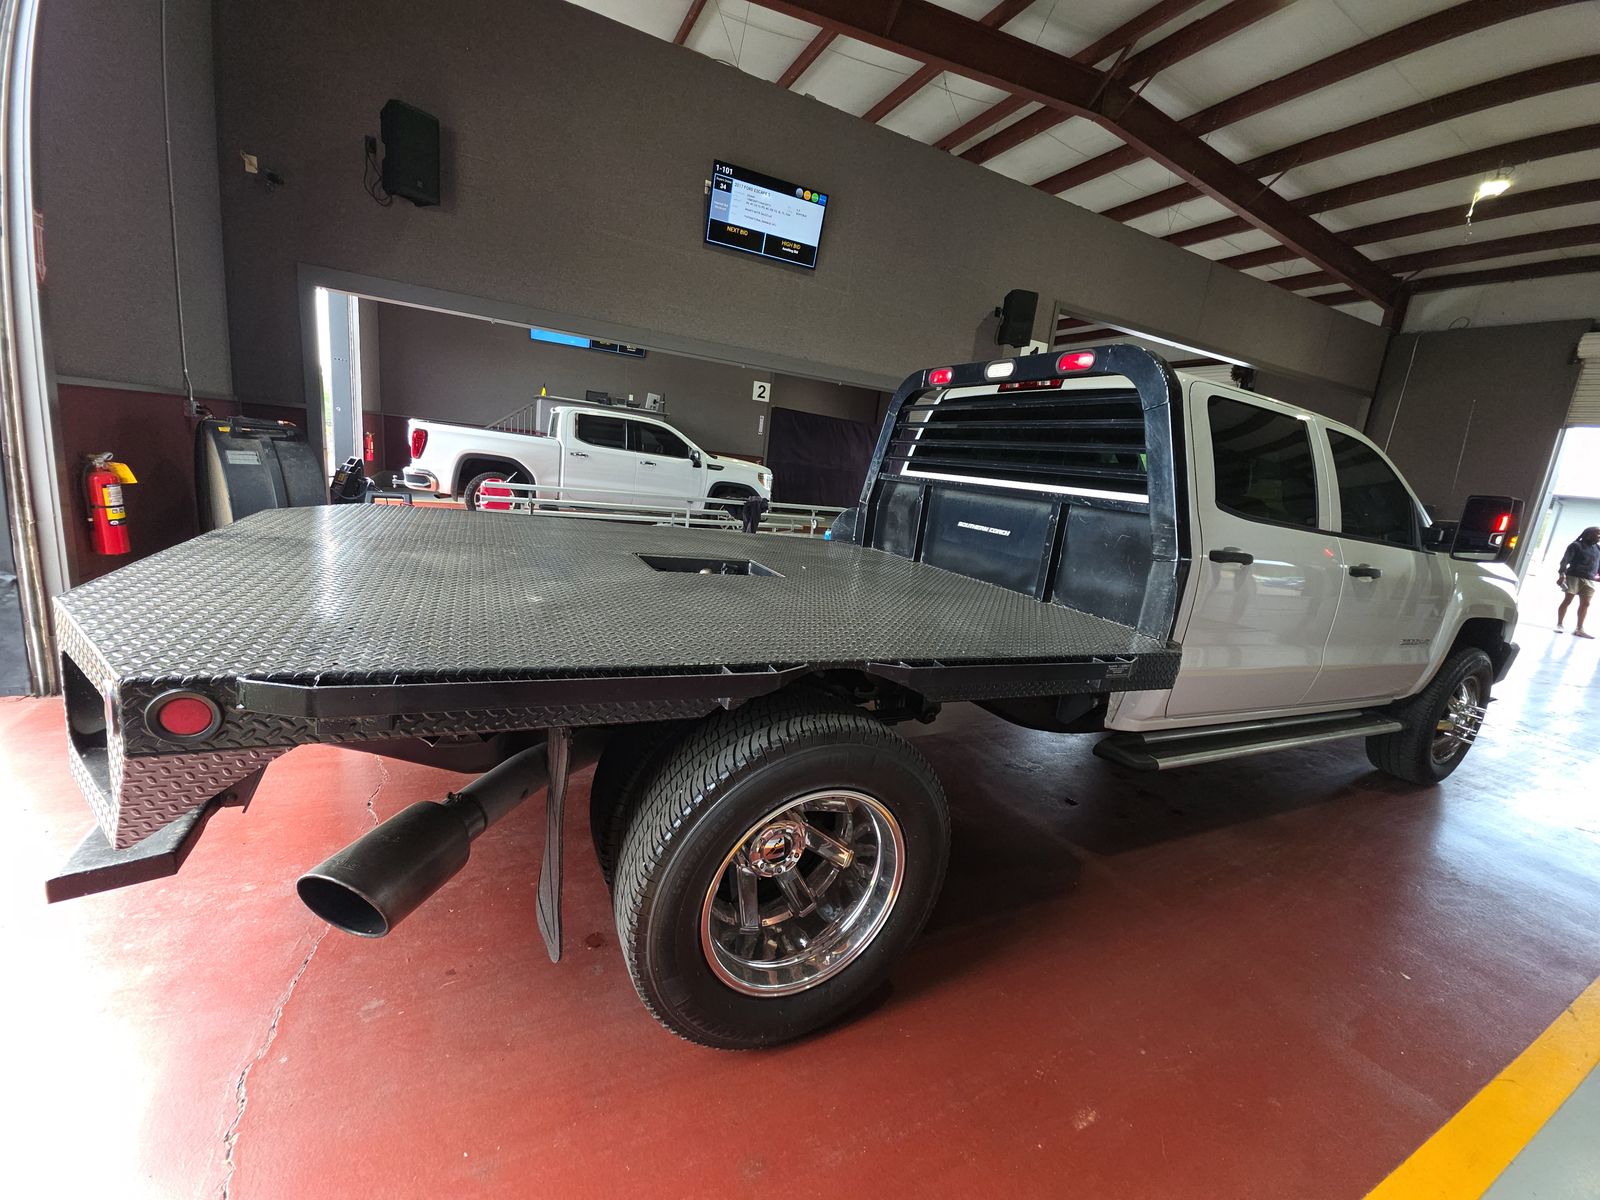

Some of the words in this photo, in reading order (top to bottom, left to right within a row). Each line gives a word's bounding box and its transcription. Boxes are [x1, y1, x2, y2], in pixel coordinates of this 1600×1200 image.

[716, 165, 733, 175] 1-101
[727, 226, 740, 234] NEXT
[782, 240, 792, 248] HIGH
[757, 385, 766, 399] 2
